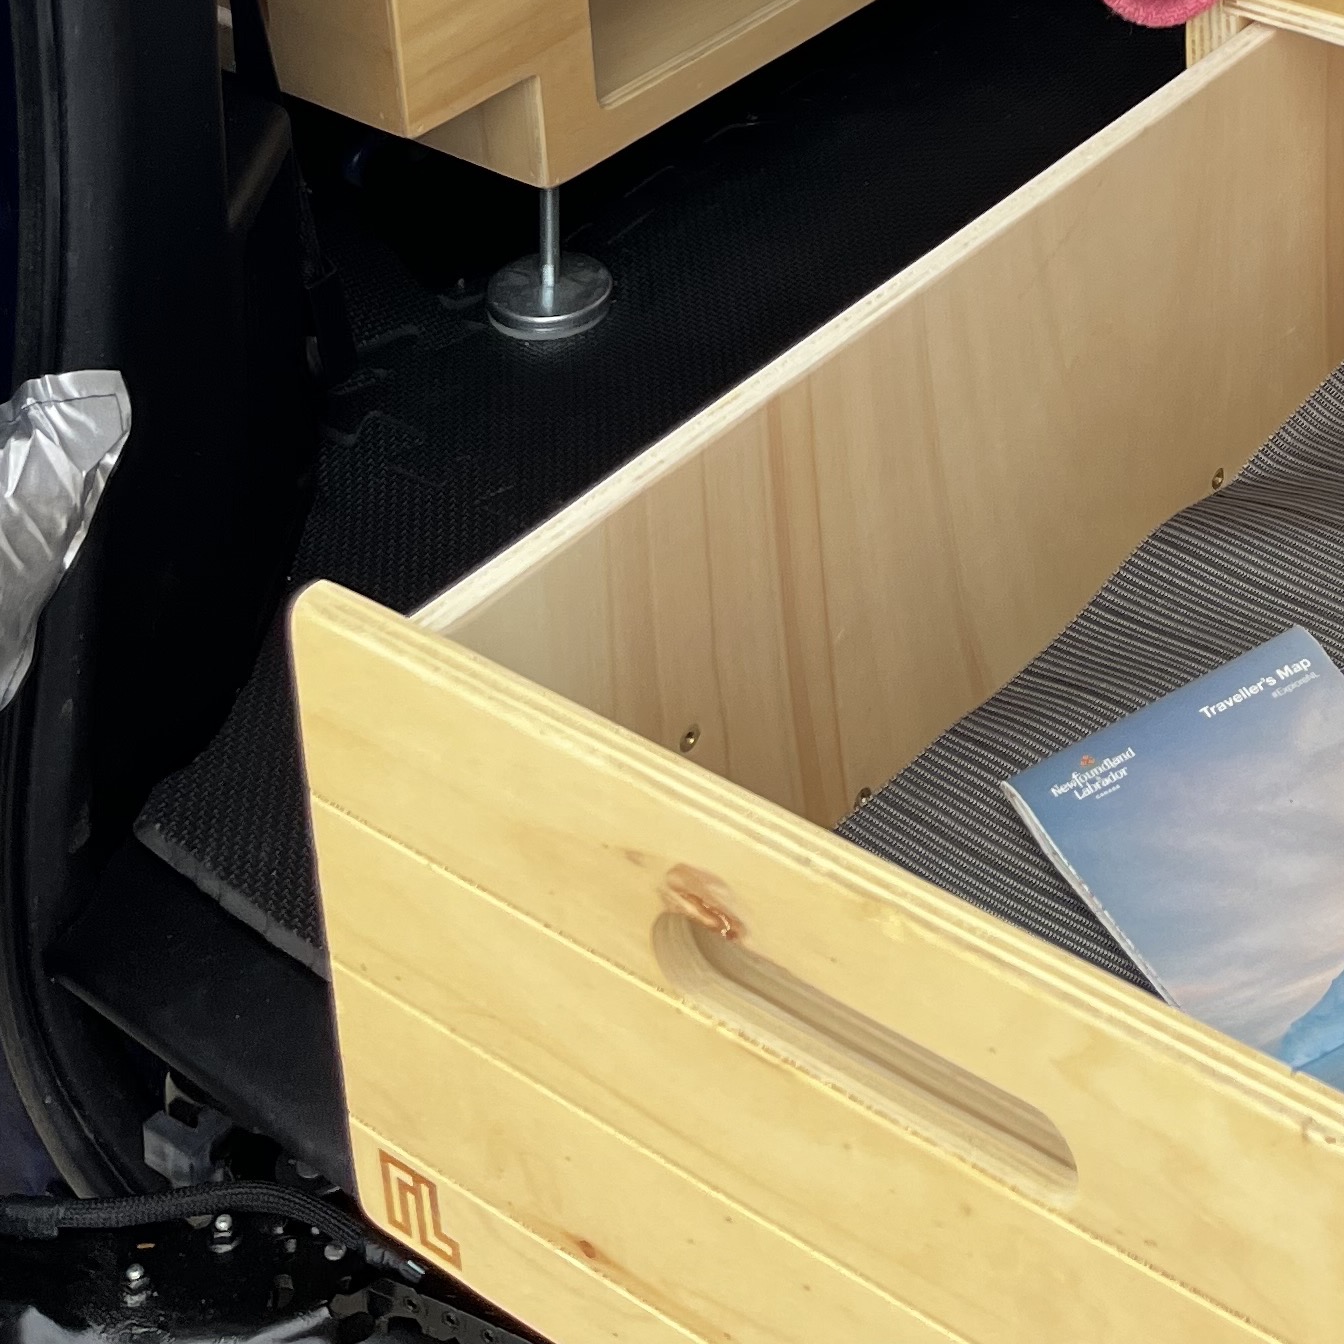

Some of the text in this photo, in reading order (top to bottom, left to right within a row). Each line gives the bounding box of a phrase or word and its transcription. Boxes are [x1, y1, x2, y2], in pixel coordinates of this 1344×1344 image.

[1199, 658, 1311, 718] Traveller's Map
[1050, 747, 1136, 797] Newfoundland
[1074, 767, 1128, 800] Labrador
